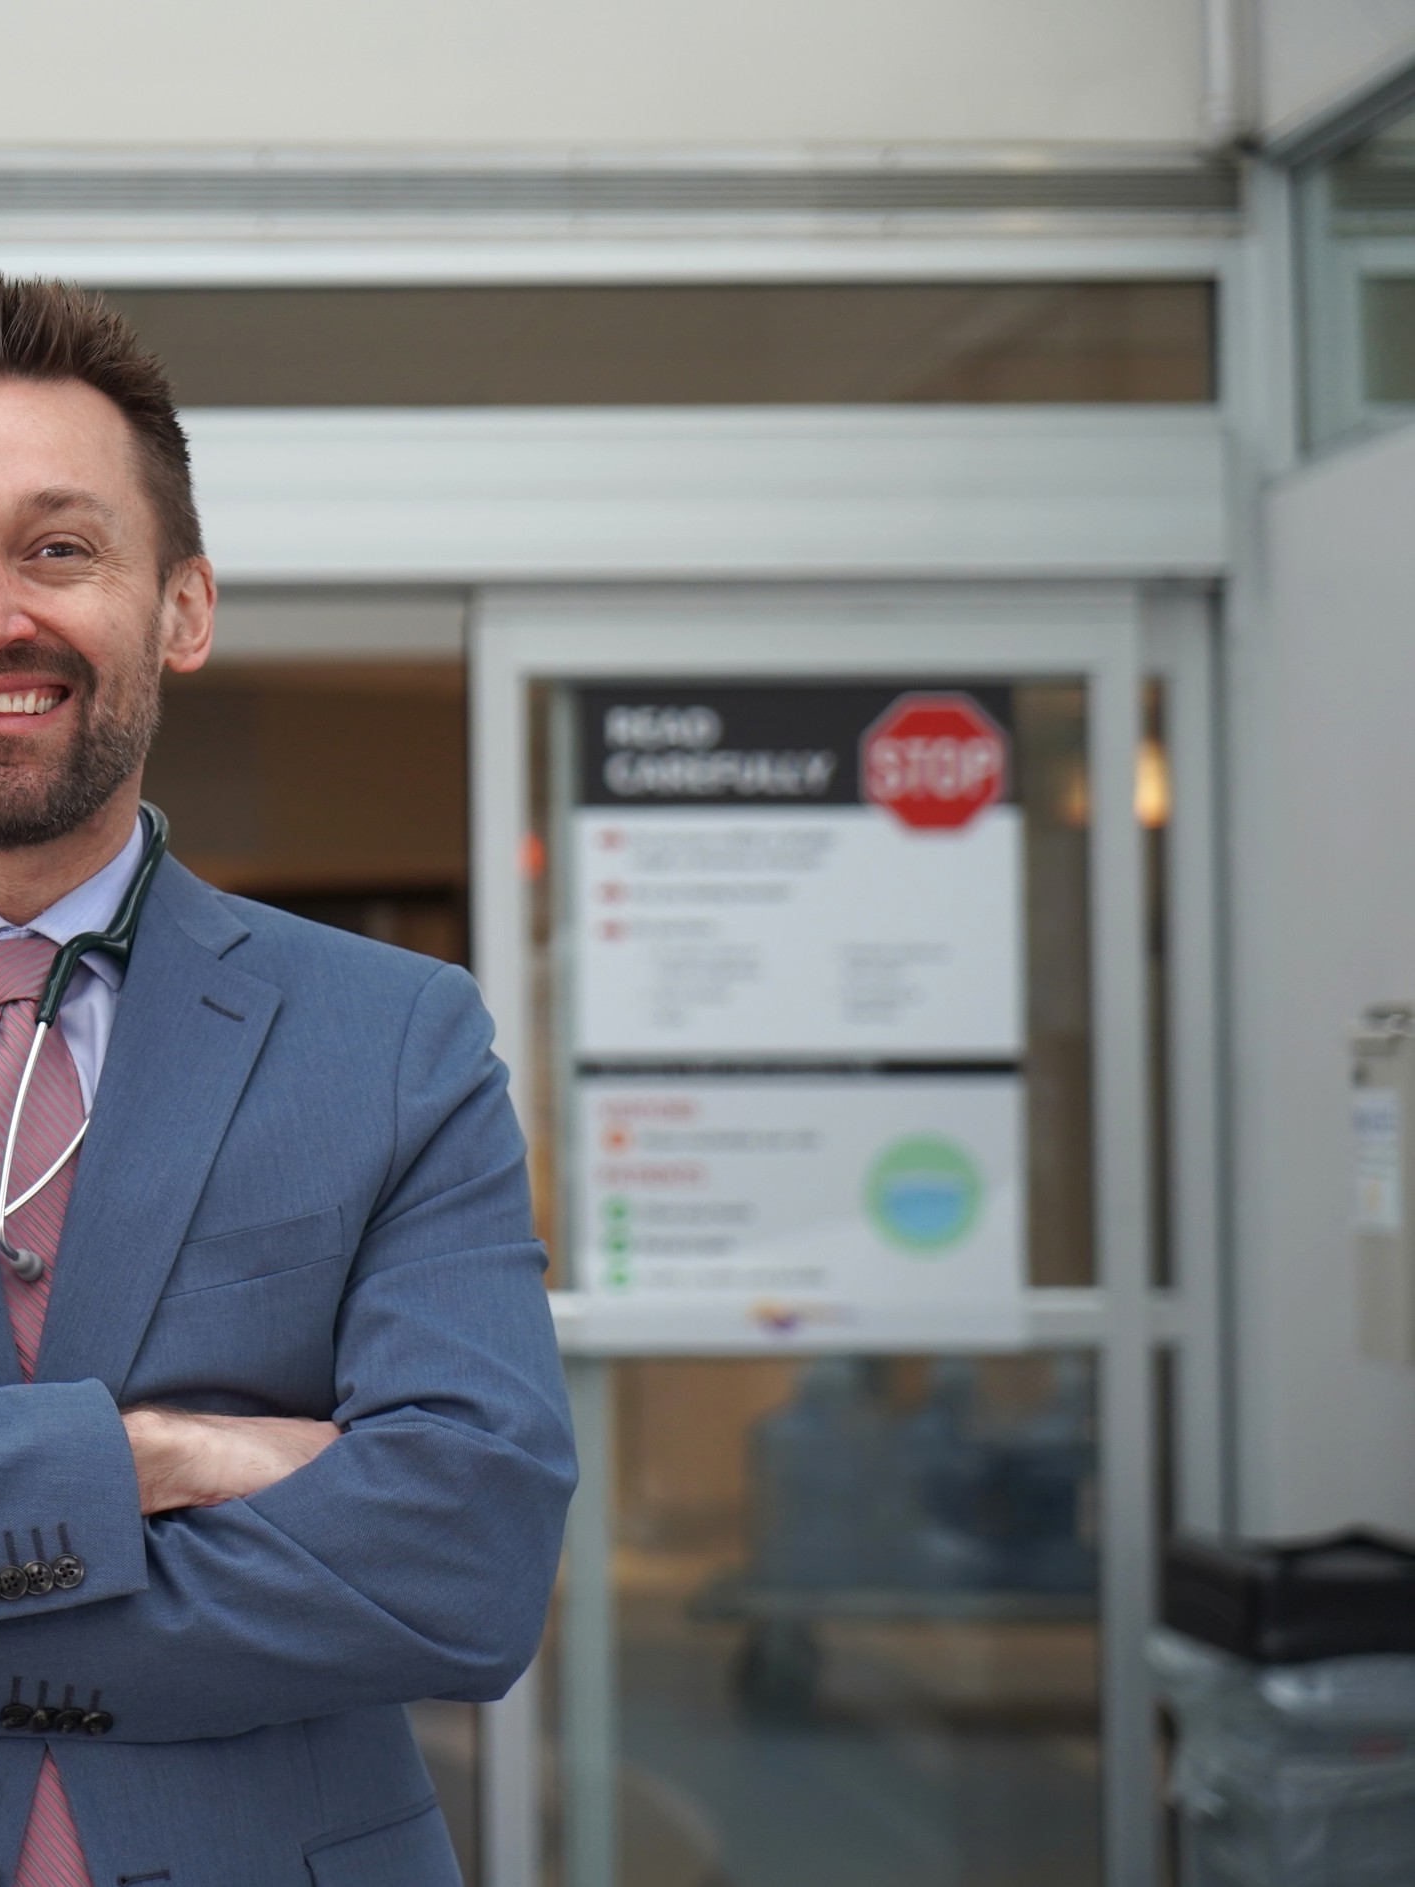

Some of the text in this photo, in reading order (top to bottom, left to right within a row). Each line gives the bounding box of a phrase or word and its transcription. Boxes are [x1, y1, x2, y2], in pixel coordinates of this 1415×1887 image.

[604, 706, 722, 747] READ
[604, 751, 836, 795] CAREFULLY
[869, 737, 1004, 799] STOP
